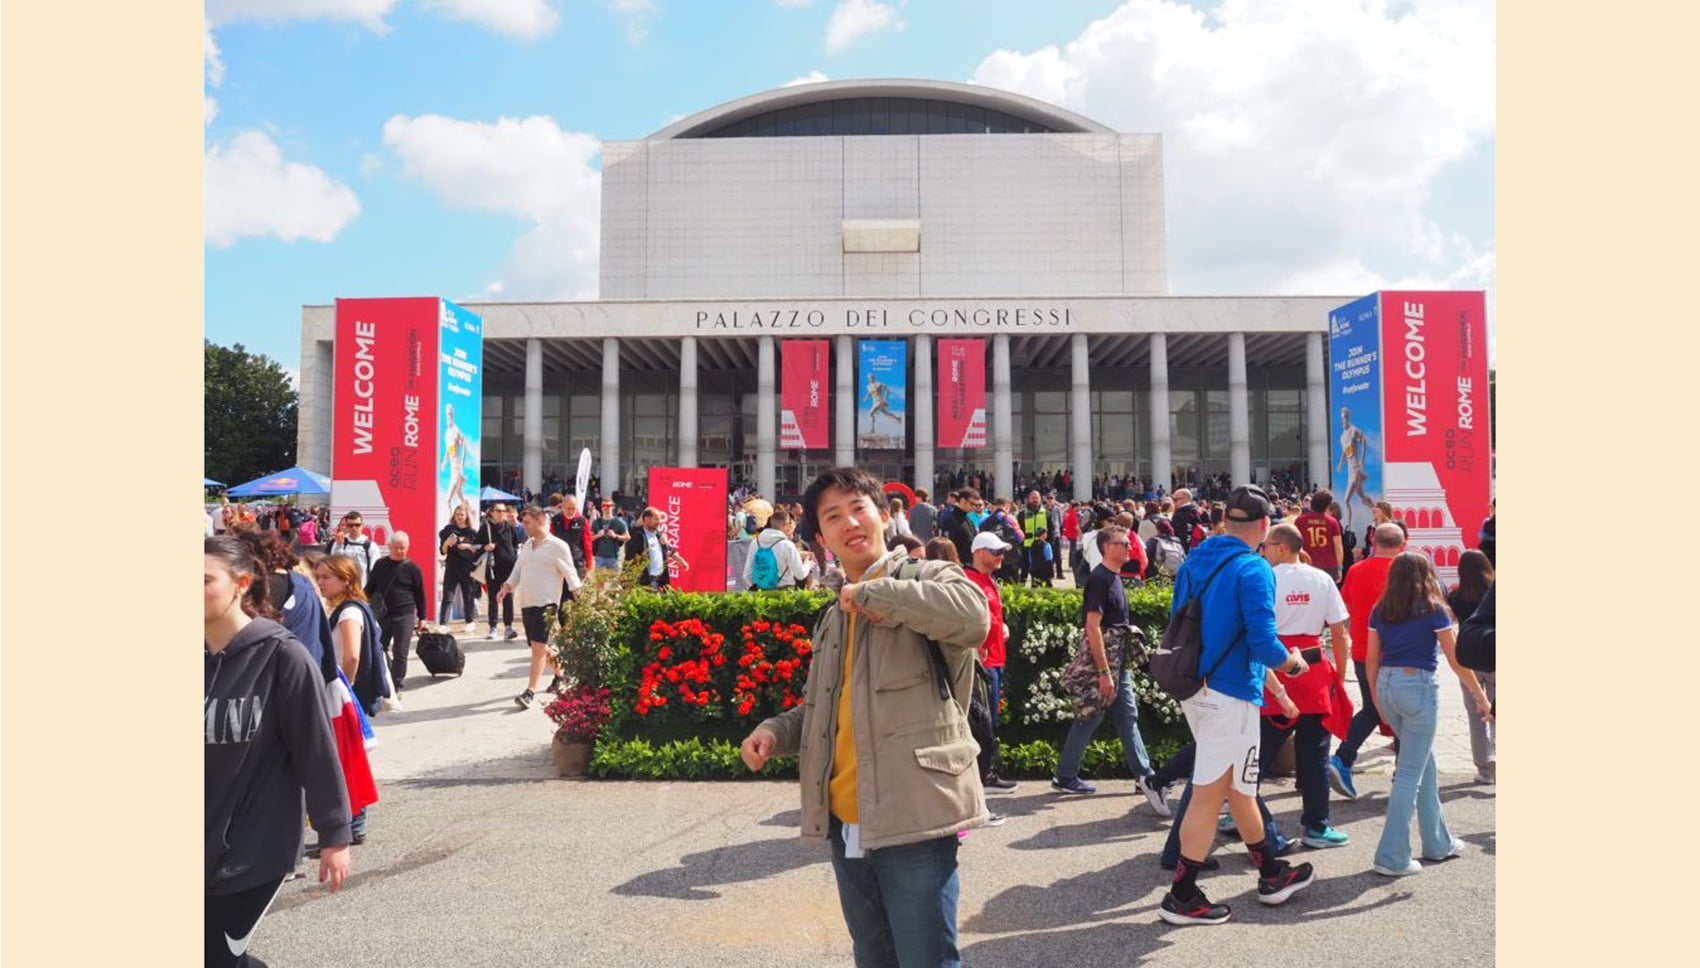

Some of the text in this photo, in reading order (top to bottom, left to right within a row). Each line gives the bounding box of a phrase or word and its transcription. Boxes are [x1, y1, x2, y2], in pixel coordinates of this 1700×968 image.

[696, 308, 1072, 329] PALAZZO DEI CONGRESSI
[353, 321, 375, 455] WELCOME
[1404, 301, 1427, 437] WELCOME
[810, 380, 819, 408] ROME
[1457, 376, 1473, 430] ROME
[404, 394, 419, 447] ROME
[389, 446, 401, 488] acea
[1445, 428, 1456, 470] acea
[668, 495, 681, 578] ENRANCE
[1306, 526, 1328, 548] 16
